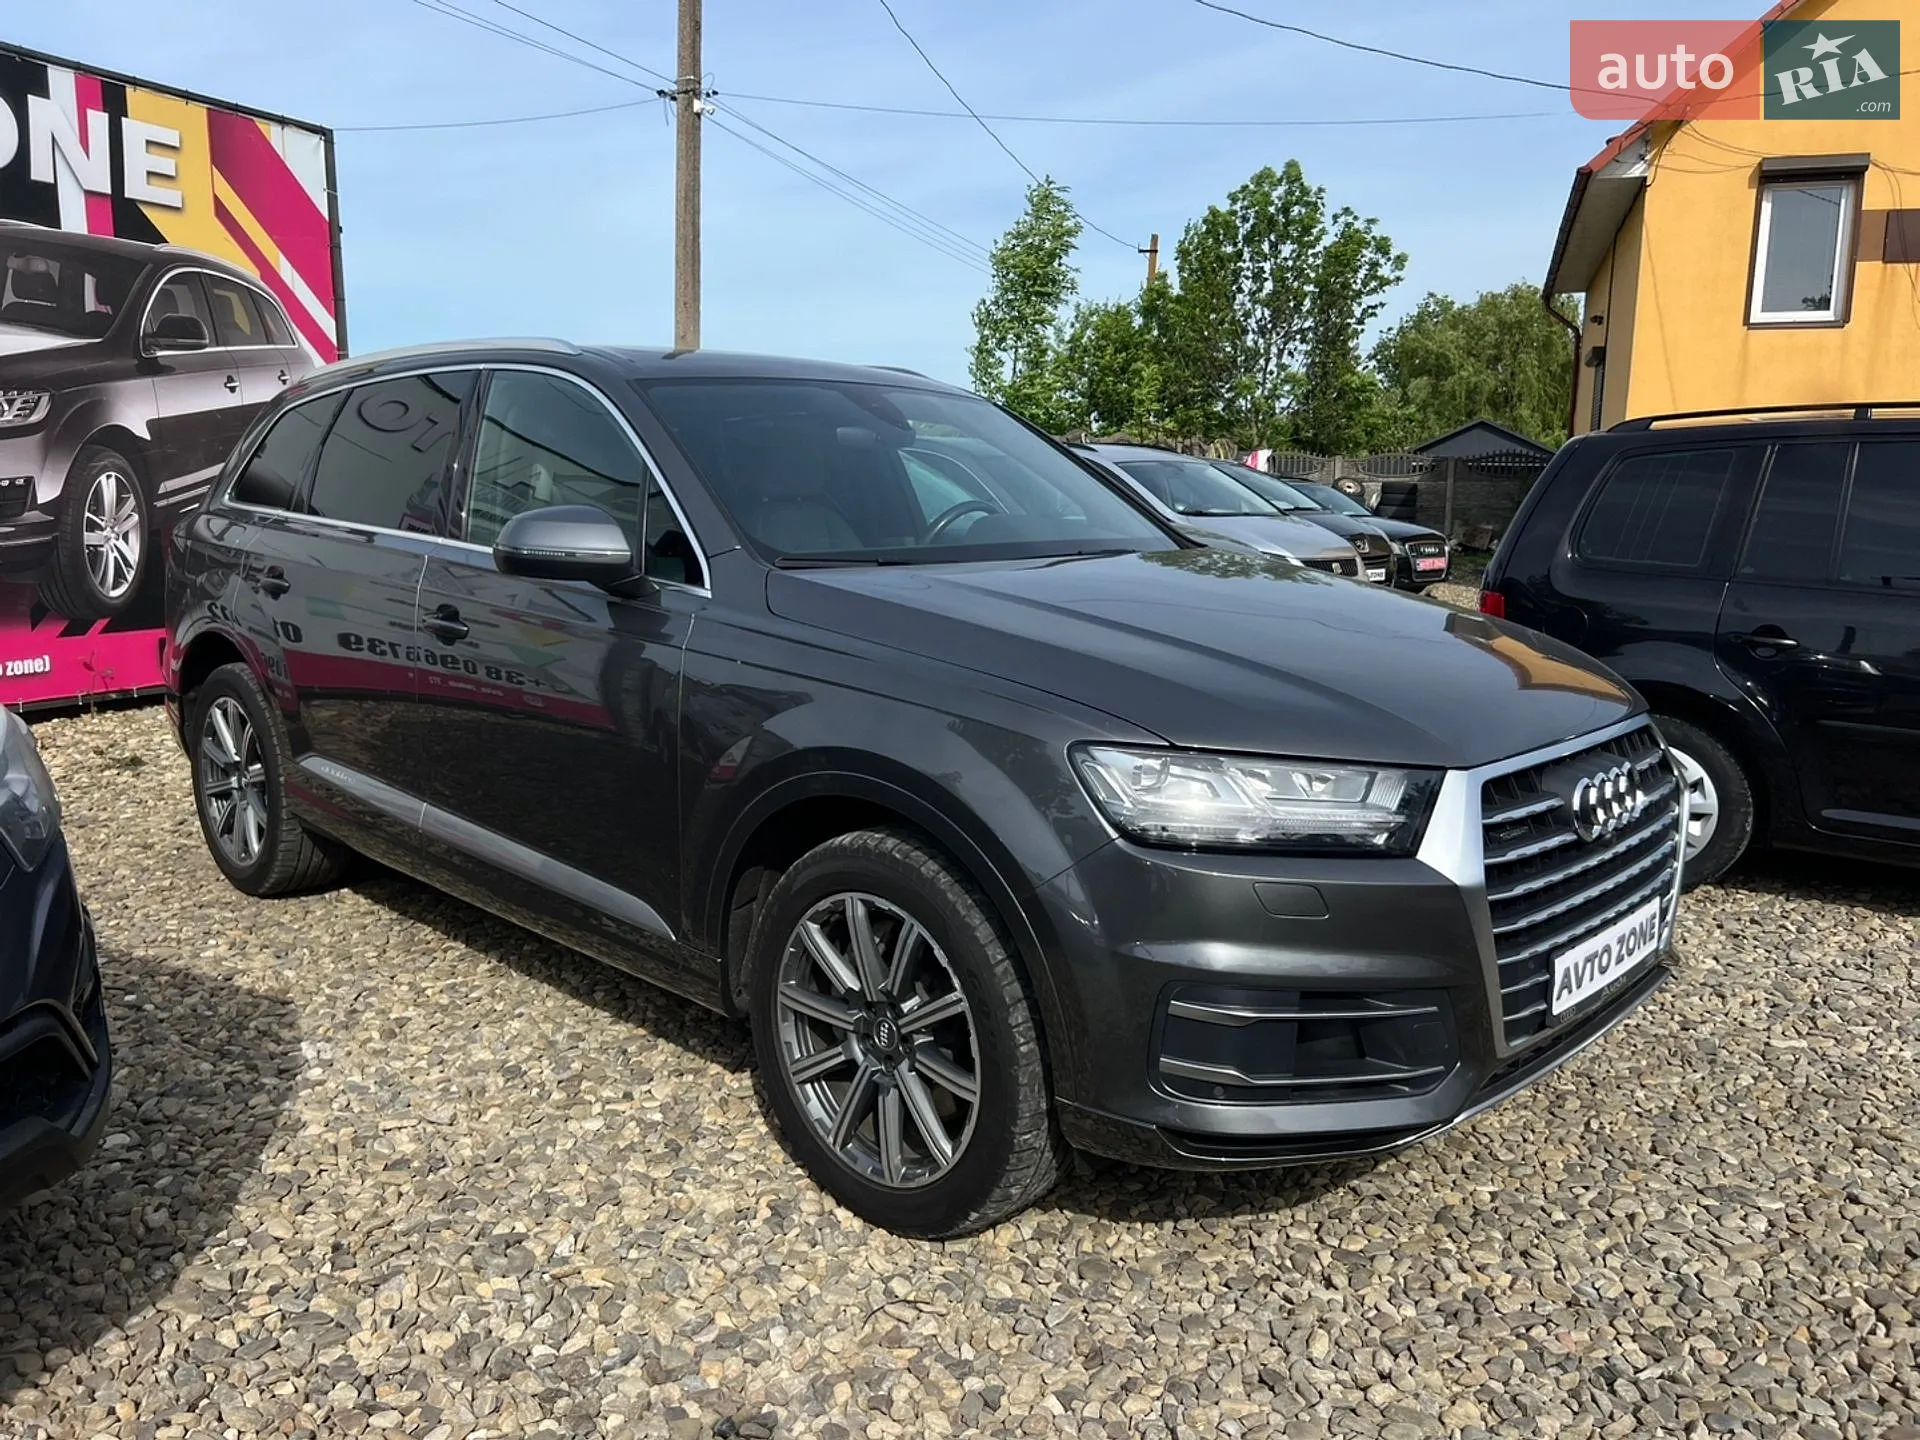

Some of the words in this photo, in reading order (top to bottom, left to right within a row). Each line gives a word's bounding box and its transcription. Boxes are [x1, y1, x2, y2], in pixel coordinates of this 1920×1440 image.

[0, 94, 183, 209] NE
[5, 654, 51, 676] zone)
[1556, 943, 1612, 1002] AVTO
[1615, 911, 1657, 966] ZONE
